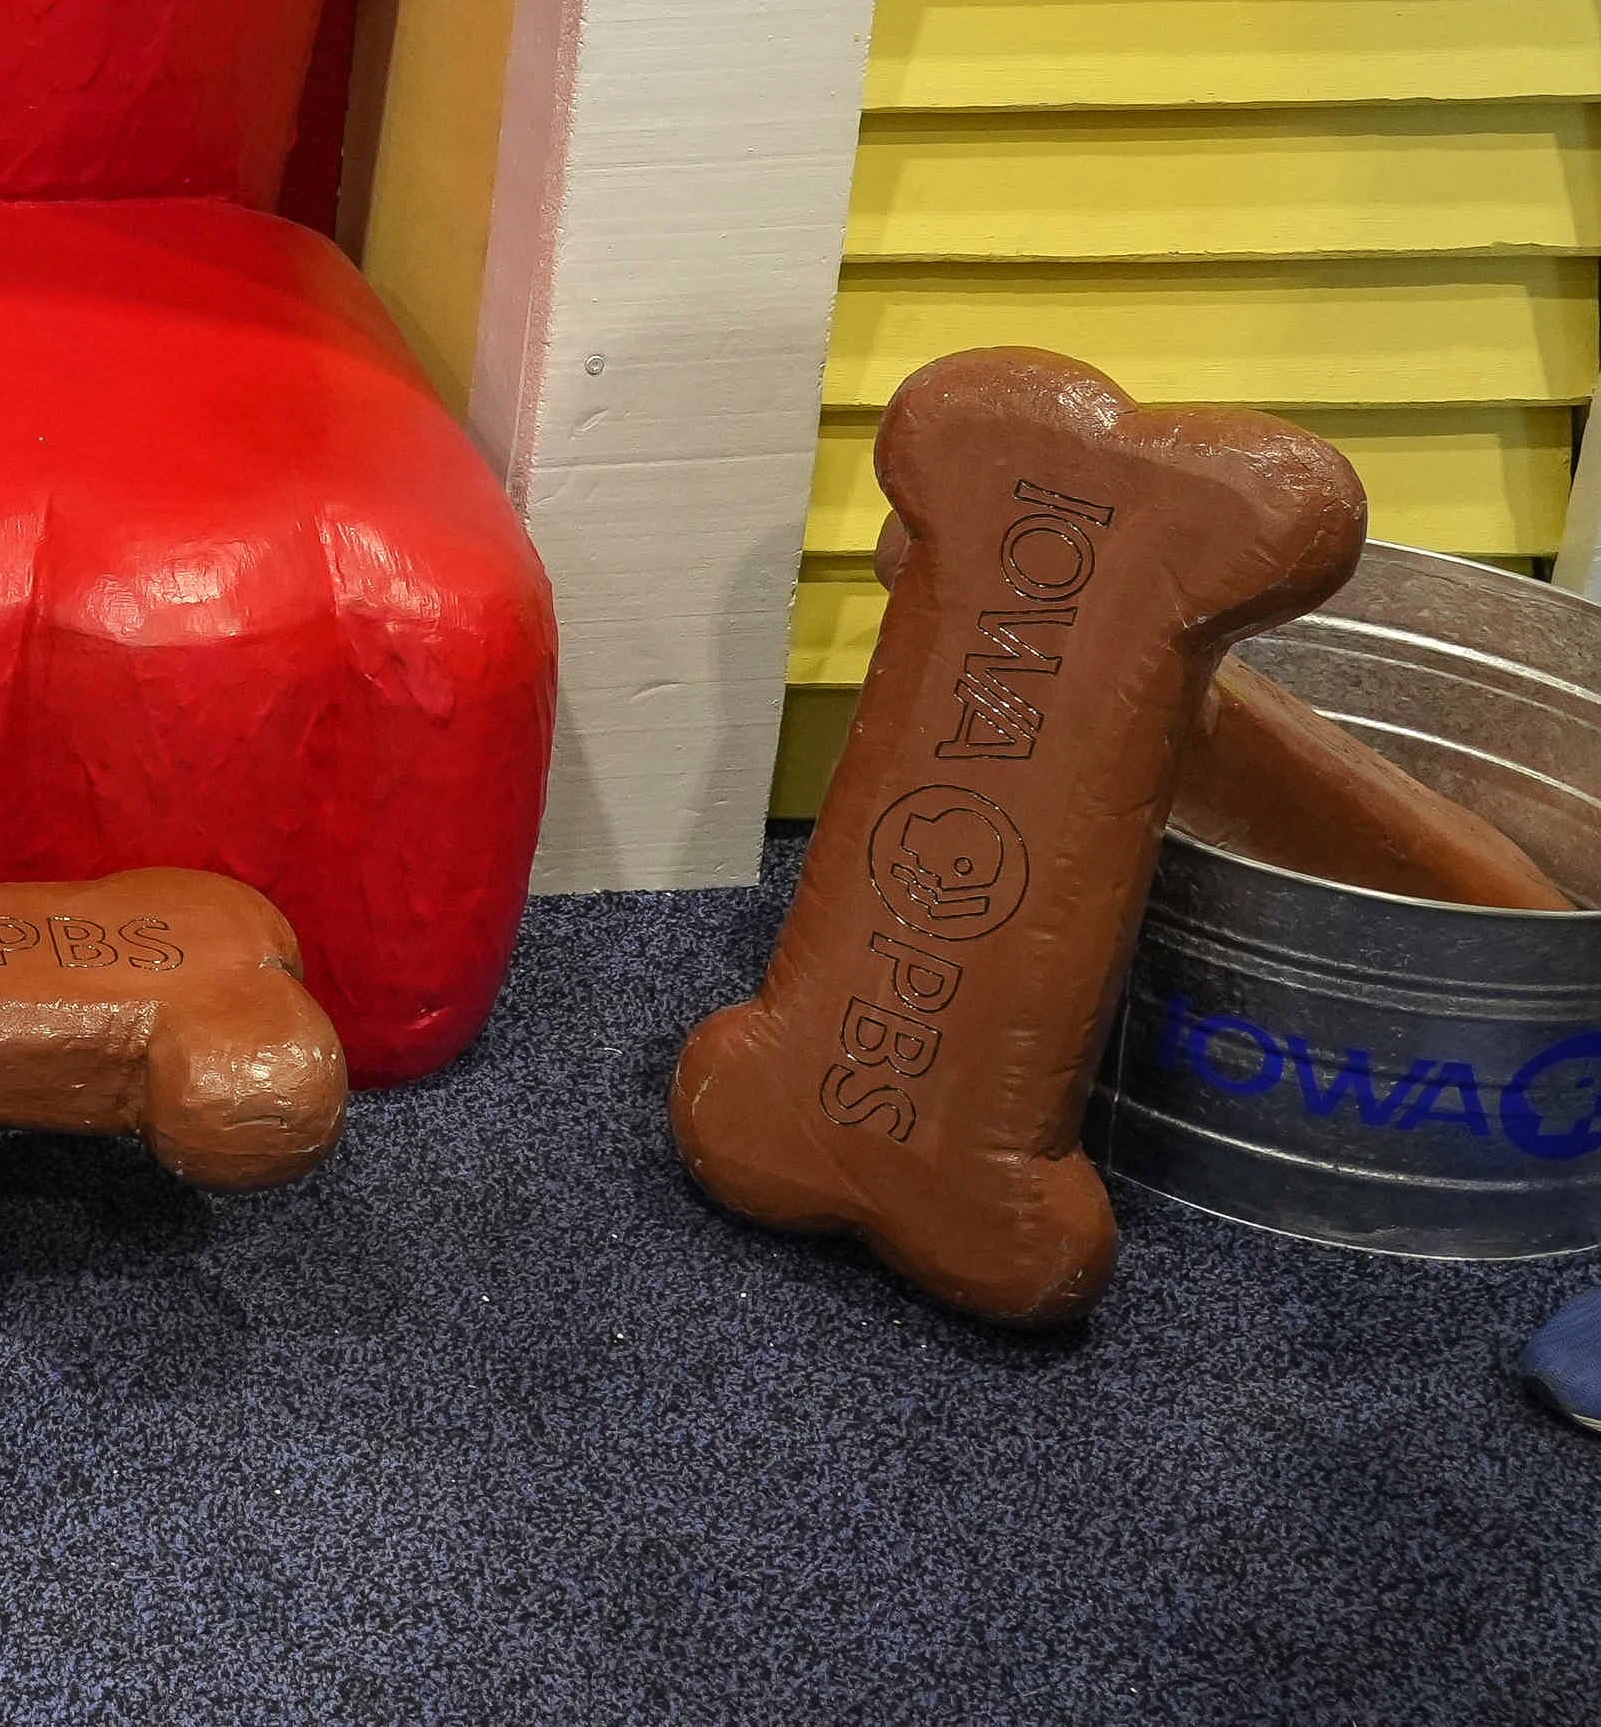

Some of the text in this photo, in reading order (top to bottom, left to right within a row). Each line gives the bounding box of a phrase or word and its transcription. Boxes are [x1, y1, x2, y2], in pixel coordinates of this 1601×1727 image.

[819, 478, 1115, 1146] IOWA PBS
[1157, 992, 1489, 1136] IOWA
